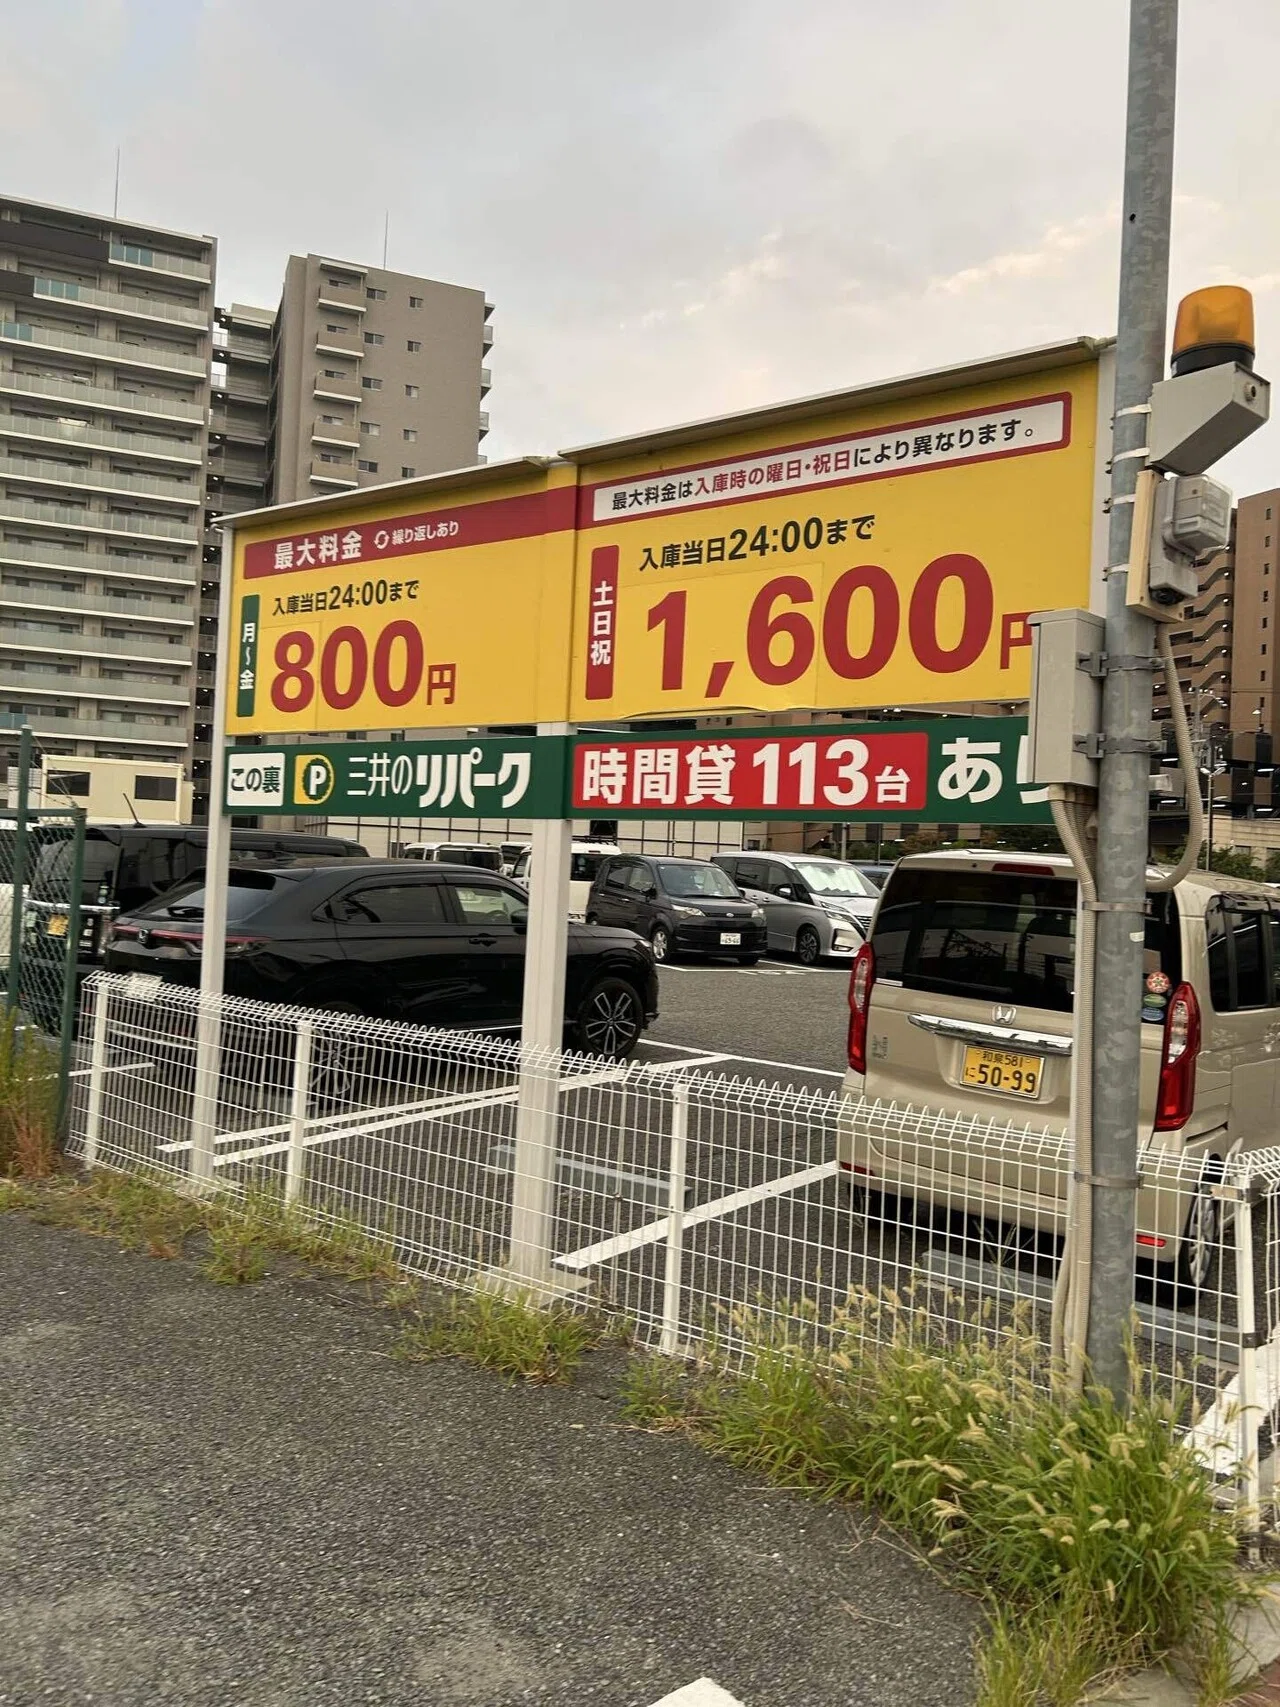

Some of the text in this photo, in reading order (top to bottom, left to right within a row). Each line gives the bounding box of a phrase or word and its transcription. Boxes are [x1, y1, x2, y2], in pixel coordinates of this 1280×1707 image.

[612, 418, 1034, 511] 最大料金は入庫時の曜日・祝日により異なります。
[274, 520, 459, 570] 最大料金 繰り返しあり
[639, 515, 875, 571] 入庫当日24:00まで
[272, 579, 420, 616] 入庫当日24:00まで
[591, 580, 613, 665] 土日祝
[270, 620, 456, 713] 800円
[230, 767, 281, 794] この裏
[346, 747, 531, 808] 三井のリパーク
[965, 1064, 1036, 1093] に 50-99
[982, 1050, 1024, 1068] 和泉581
